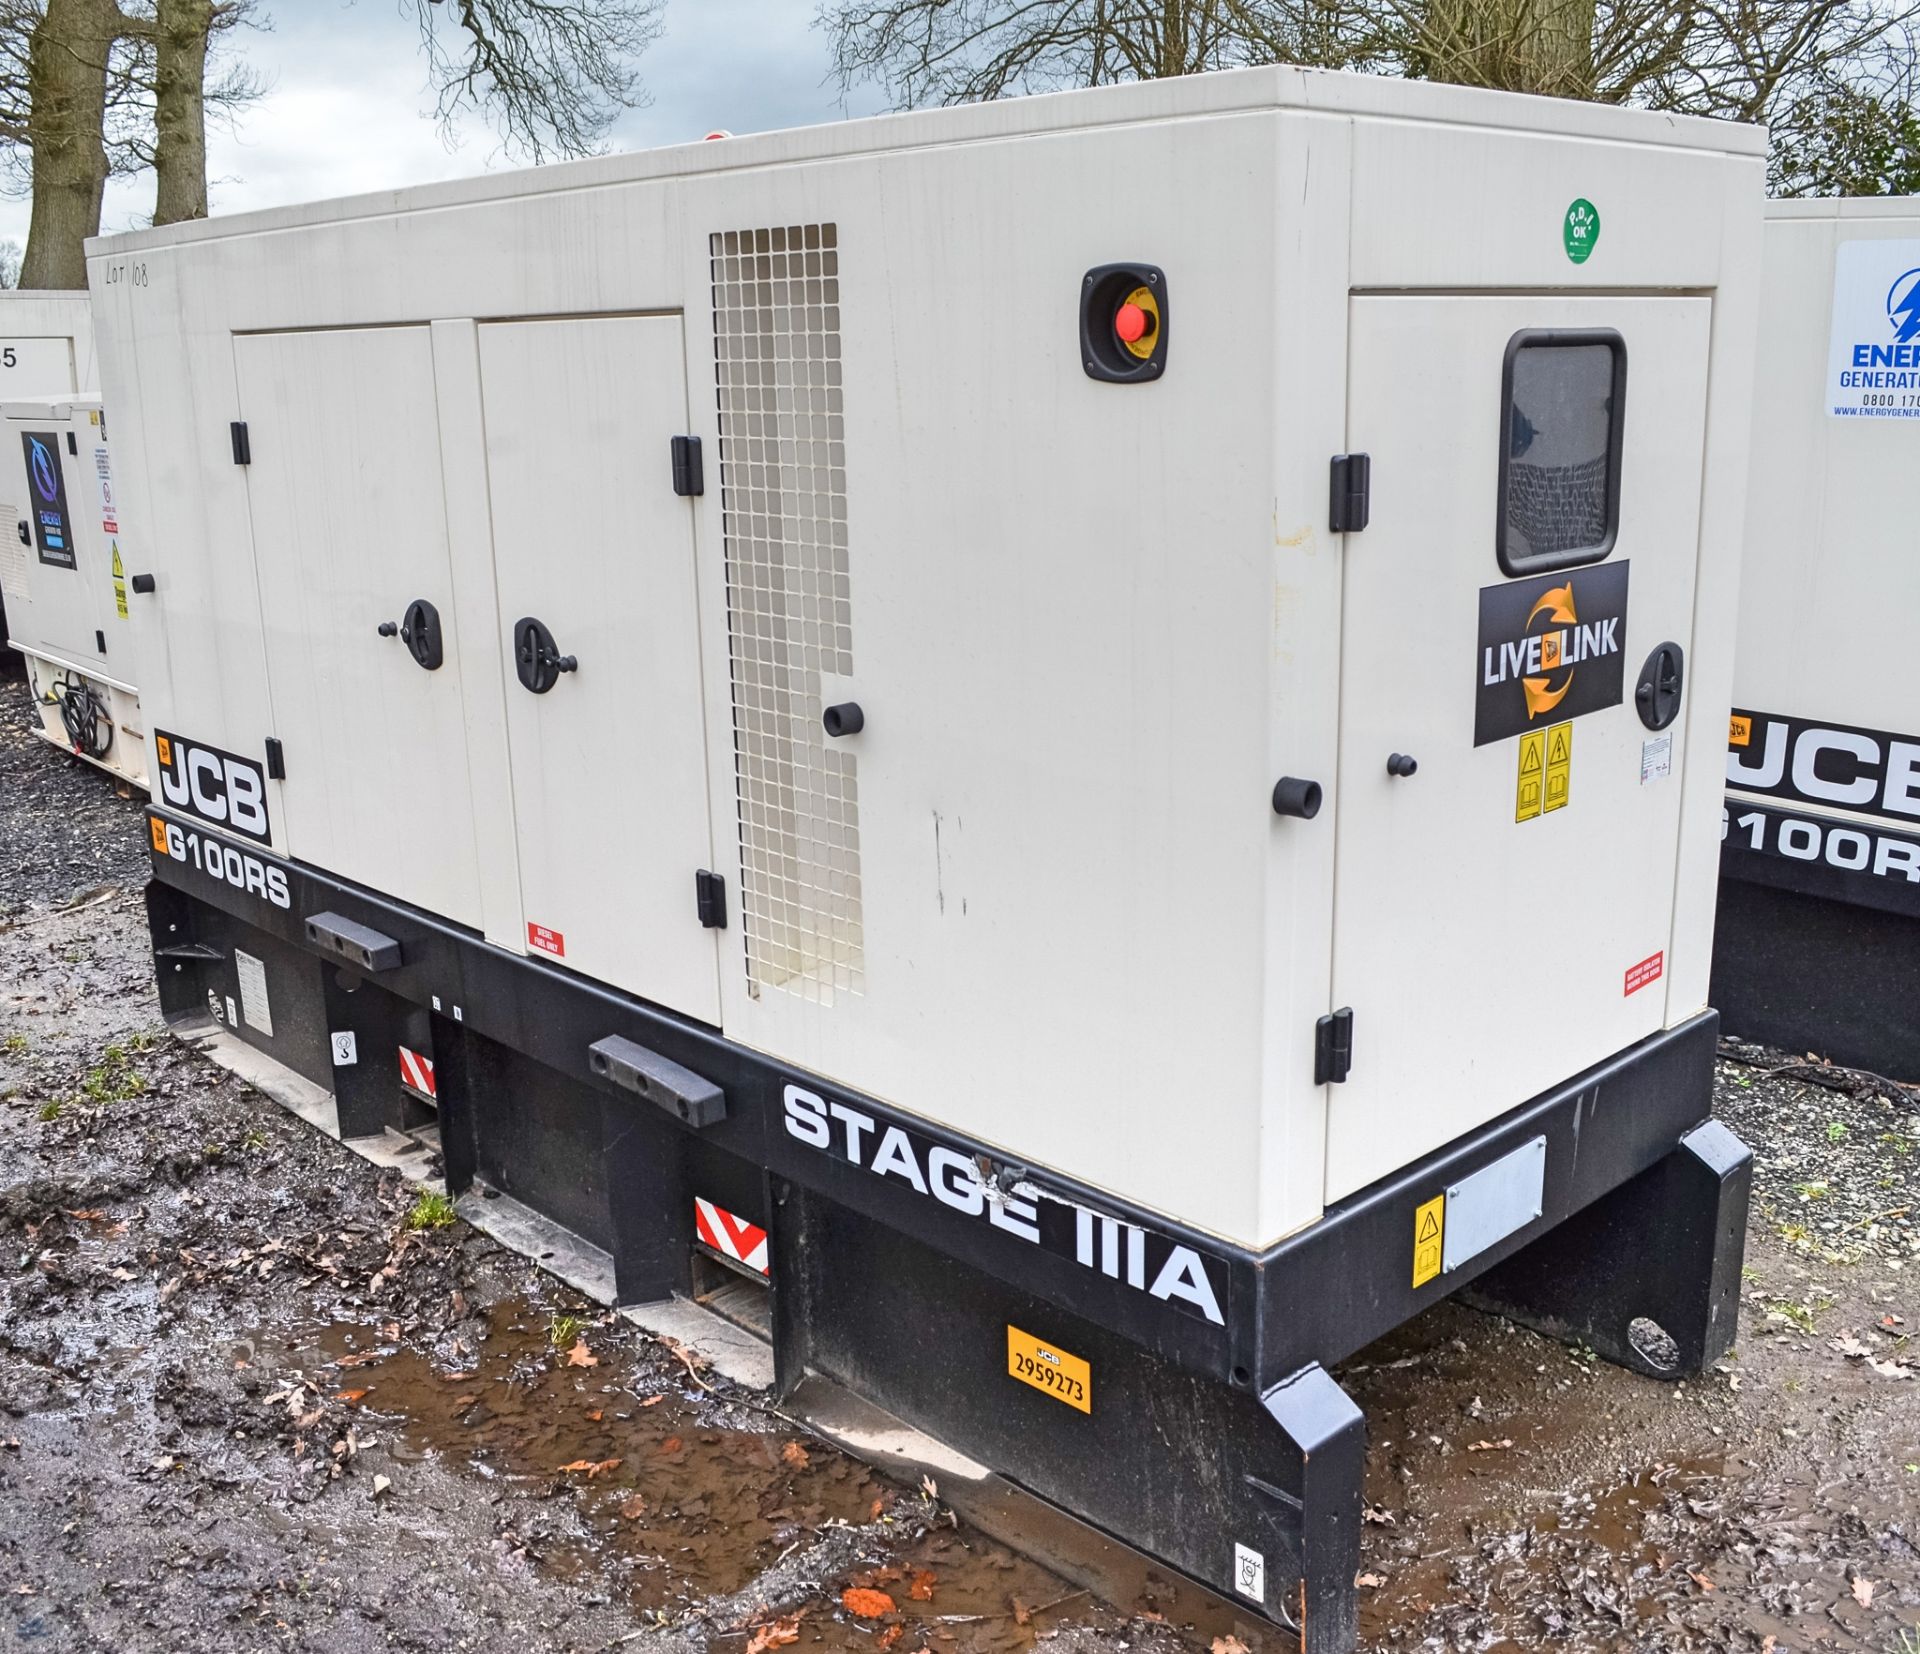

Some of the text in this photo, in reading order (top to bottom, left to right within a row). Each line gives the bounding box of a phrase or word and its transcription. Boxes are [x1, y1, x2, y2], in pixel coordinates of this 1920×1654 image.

[1573, 226, 1587, 238] OK
[106, 261, 148, 287] LOT 108
[1863, 394, 1894, 407] 0800
[1484, 635, 1541, 686] LIVE
[1560, 617, 1619, 666] LINK
[161, 742, 267, 836] JCB
[166, 823, 291, 910] G100RS
[1016, 1353, 1084, 1402] 2959273
